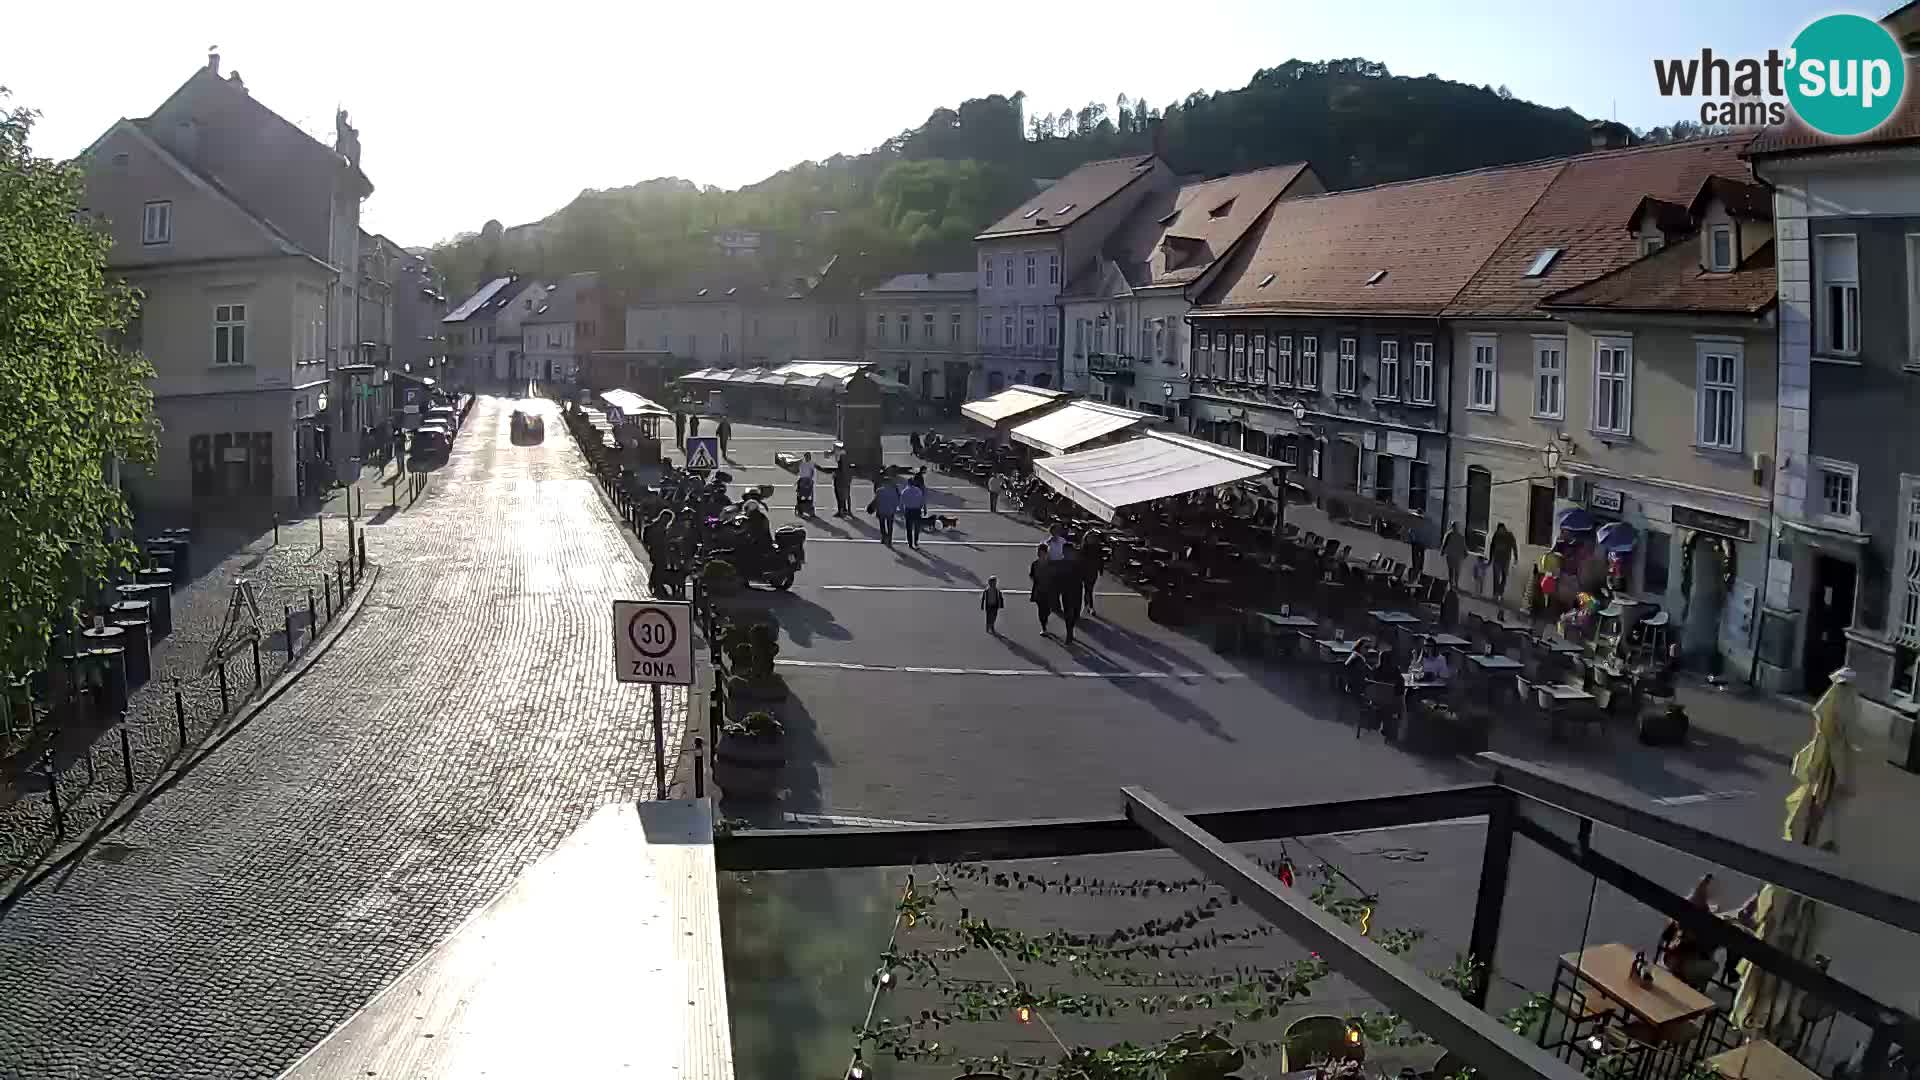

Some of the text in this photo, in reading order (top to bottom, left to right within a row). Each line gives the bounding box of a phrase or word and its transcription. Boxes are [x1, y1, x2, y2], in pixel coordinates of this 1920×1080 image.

[407, 391, 416, 402] P
[642, 623, 665, 645] 30
[632, 661, 677, 678] ZONA
